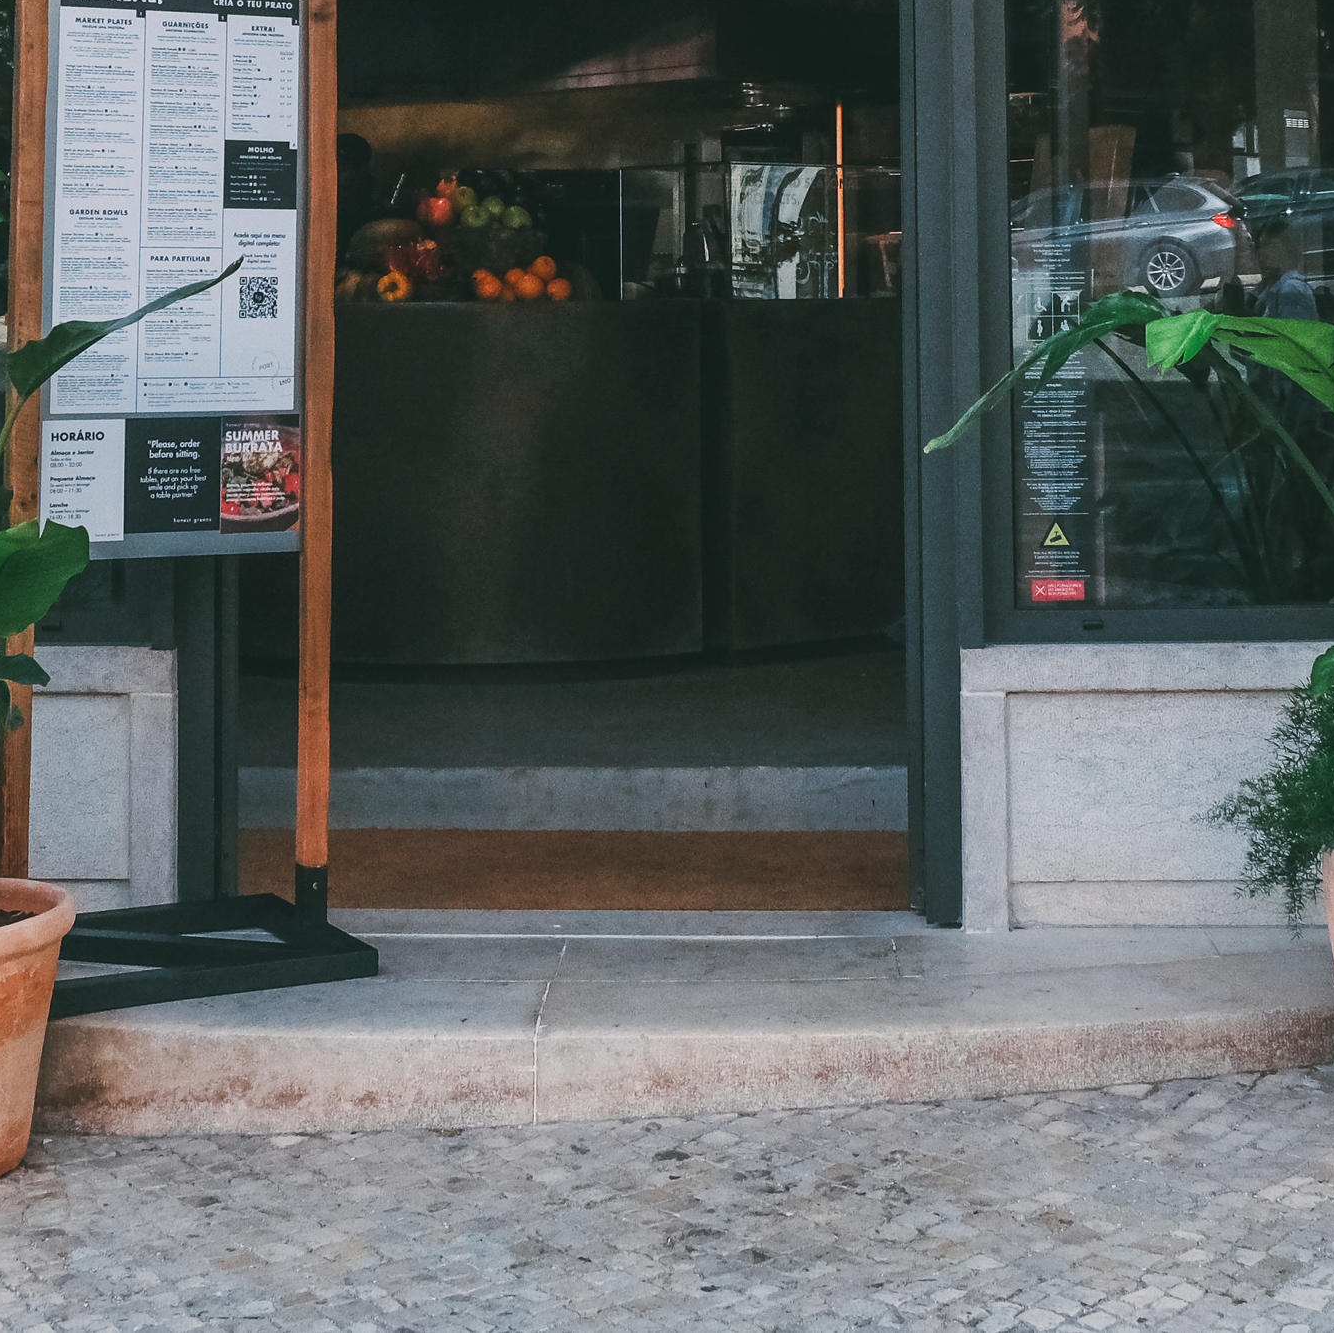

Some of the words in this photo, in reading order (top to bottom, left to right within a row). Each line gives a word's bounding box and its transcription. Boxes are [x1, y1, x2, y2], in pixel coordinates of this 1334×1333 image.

[236, 0, 244, 7] O
[246, 0, 262, 8] TEU
[264, 0, 293, 10] PRATO
[107, 18, 133, 26] PLATES
[247, 146, 275, 154] MOLHO
[69, 208, 100, 216] GARDEN
[50, 428, 105, 442] HORÁRIO
[225, 429, 280, 442] SUMMER
[179, 438, 201, 448] order
[224, 441, 283, 454] BURRATA
[149, 449, 174, 459] before
[175, 449, 201, 460] sitting.
[153, 466, 168, 475] there
[160, 476, 170, 484] put
[180, 476, 194, 484] your
[194, 474, 207, 482] best
[164, 482, 176, 490] and
[156, 490, 171, 499] table
